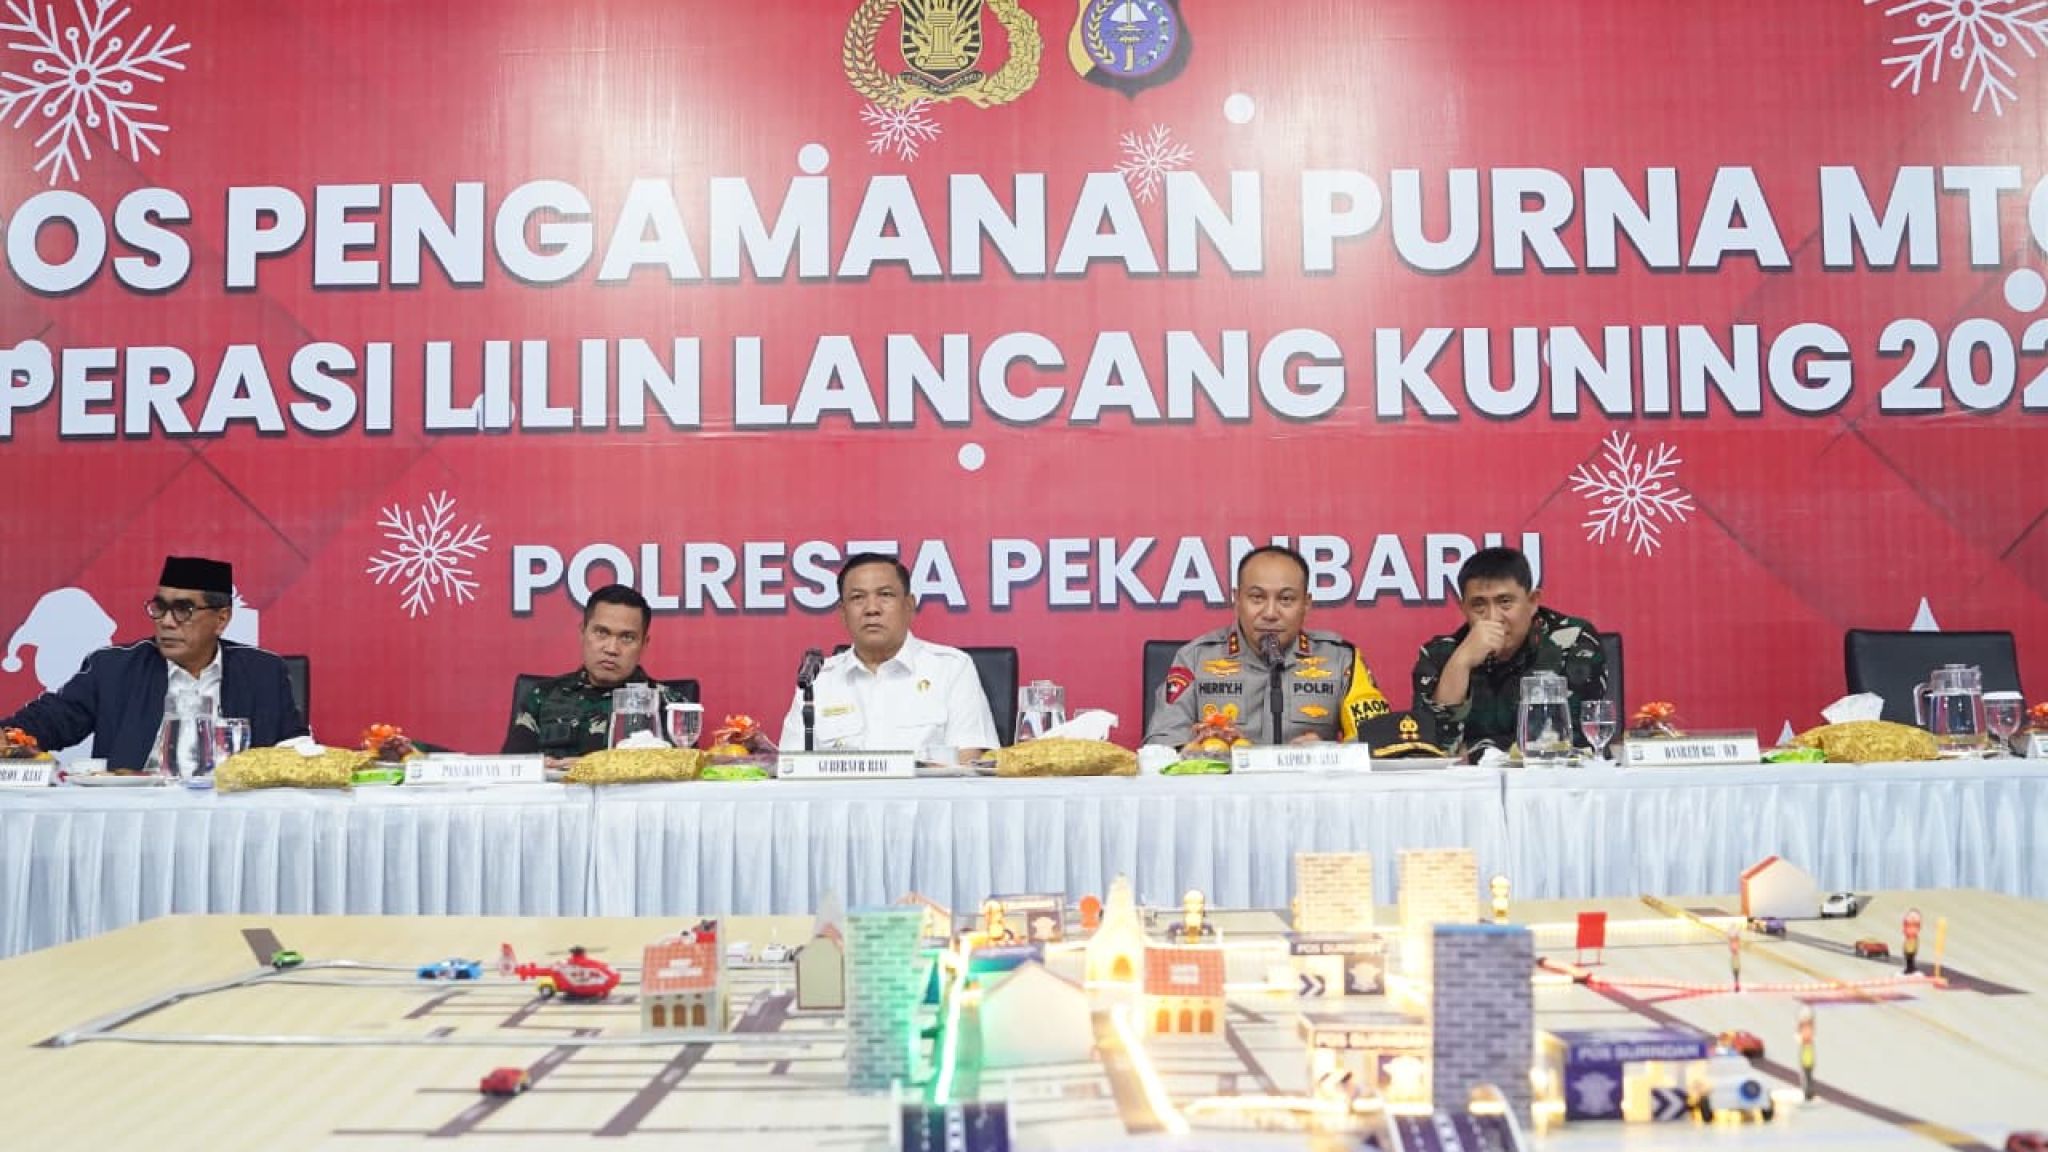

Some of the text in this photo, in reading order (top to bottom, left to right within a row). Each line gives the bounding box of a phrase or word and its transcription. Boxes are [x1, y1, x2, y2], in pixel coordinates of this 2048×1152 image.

[6, 165, 2048, 292] OS PENGAMANAN PURNA MT
[0, 340, 393, 437] PERASI
[425, 336, 701, 432] LILIN
[735, 328, 1346, 427] LANCANG
[1374, 322, 1853, 417] KUNING
[1293, 682, 1334, 695] POLRI
